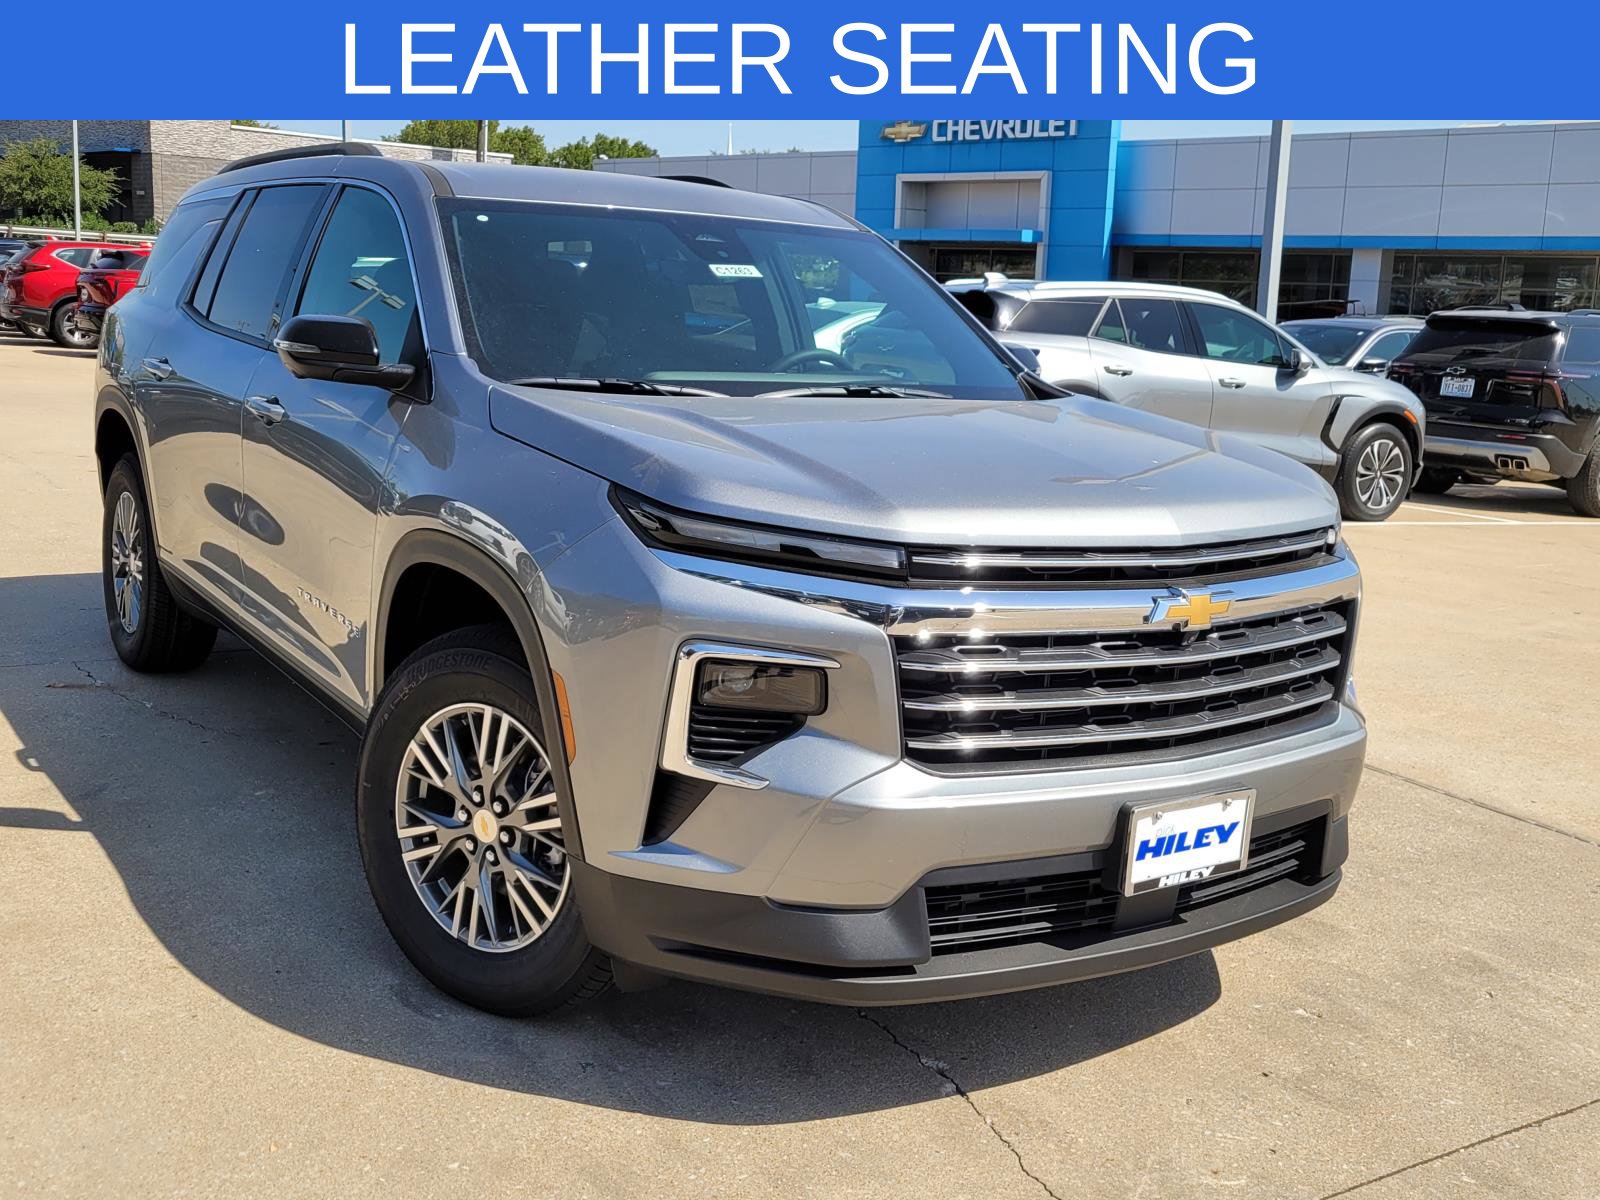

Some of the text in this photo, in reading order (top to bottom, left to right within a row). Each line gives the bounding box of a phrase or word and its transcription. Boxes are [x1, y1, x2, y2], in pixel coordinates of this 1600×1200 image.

[931, 120, 1077, 142] CHEVROLET
[296, 586, 360, 638] TRAVERSE
[406, 652, 491, 681] BRIDGESTONE
[1135, 821, 1240, 861] HILEY
[1158, 865, 1216, 888] HILEY
